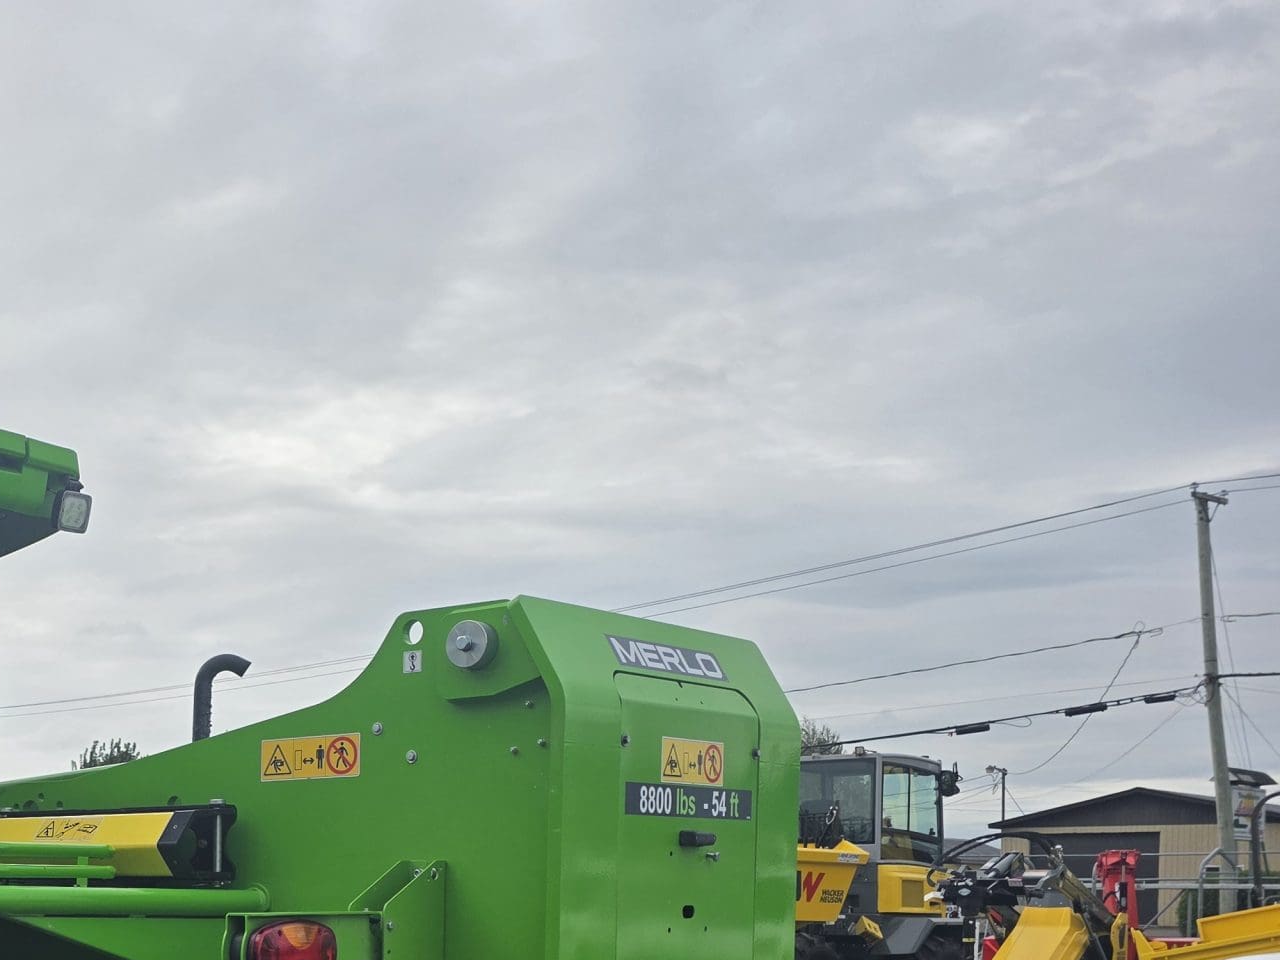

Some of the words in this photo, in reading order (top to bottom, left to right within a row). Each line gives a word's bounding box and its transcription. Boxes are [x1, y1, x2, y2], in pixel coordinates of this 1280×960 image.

[609, 637, 723, 679] MERLO
[640, 785, 672, 815] 8800
[676, 787, 696, 815] lbs
[711, 791, 727, 817] 54
[729, 792, 740, 817] ft
[821, 889, 845, 897] WACKER
